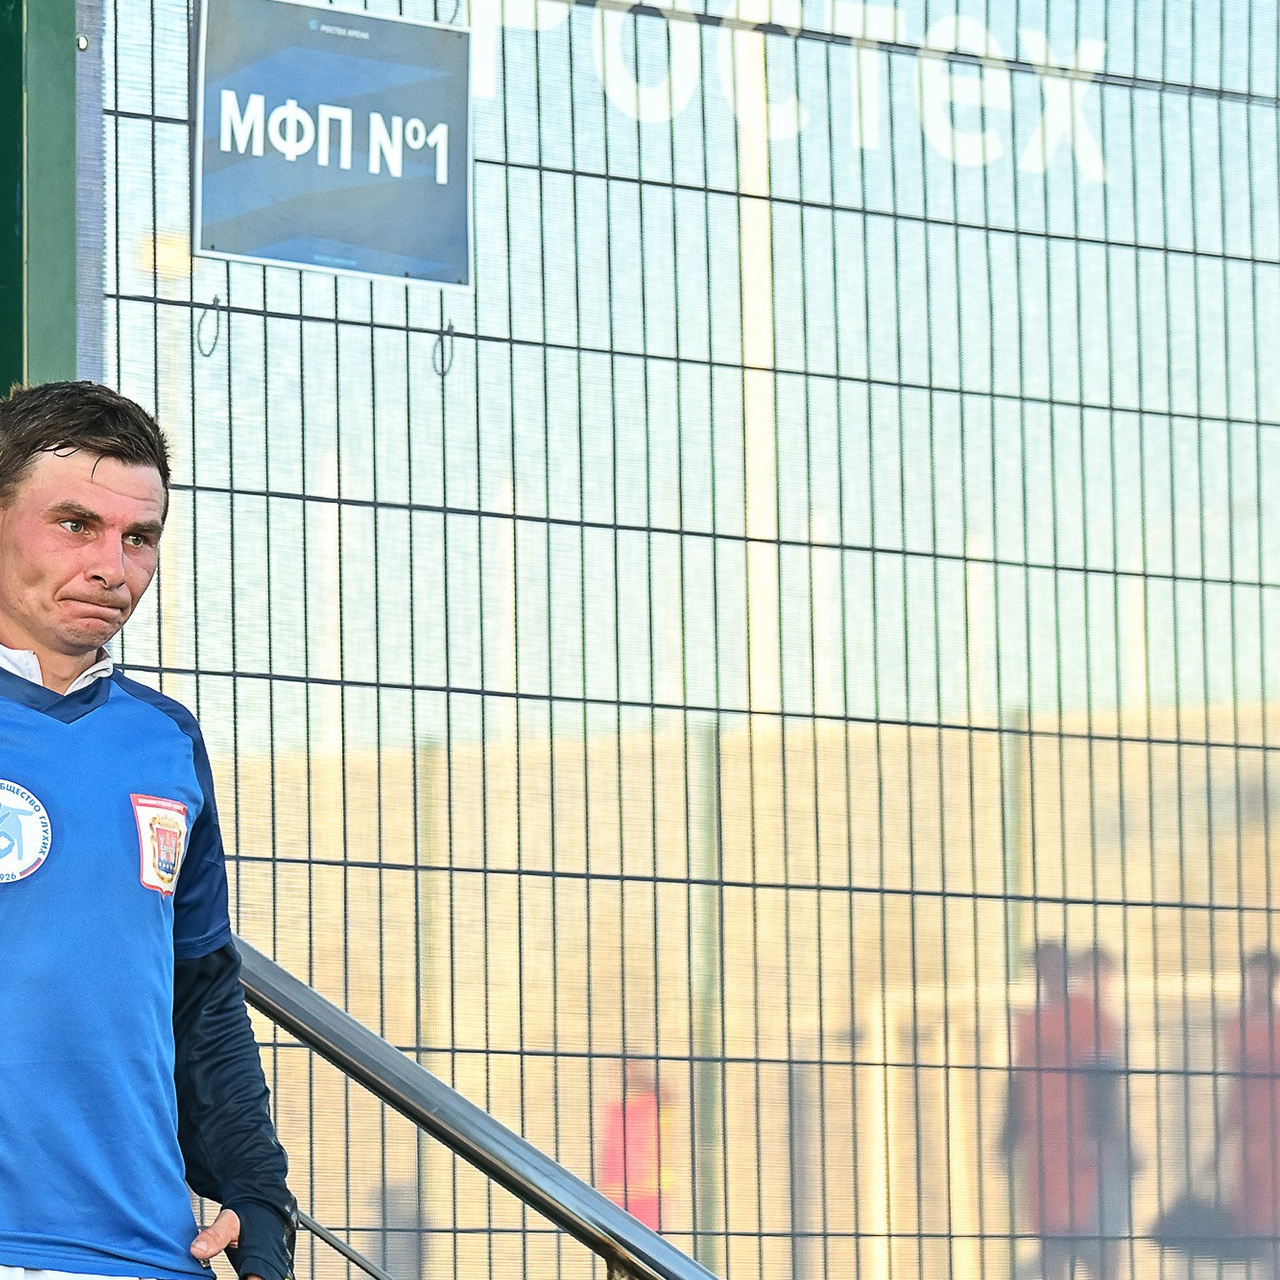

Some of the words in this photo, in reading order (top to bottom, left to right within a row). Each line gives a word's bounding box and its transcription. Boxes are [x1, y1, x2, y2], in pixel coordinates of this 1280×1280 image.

[219, 89, 354, 171] МФП
[368, 111, 449, 185] №1
[39, 815, 50, 857] ГЛУХИХ
